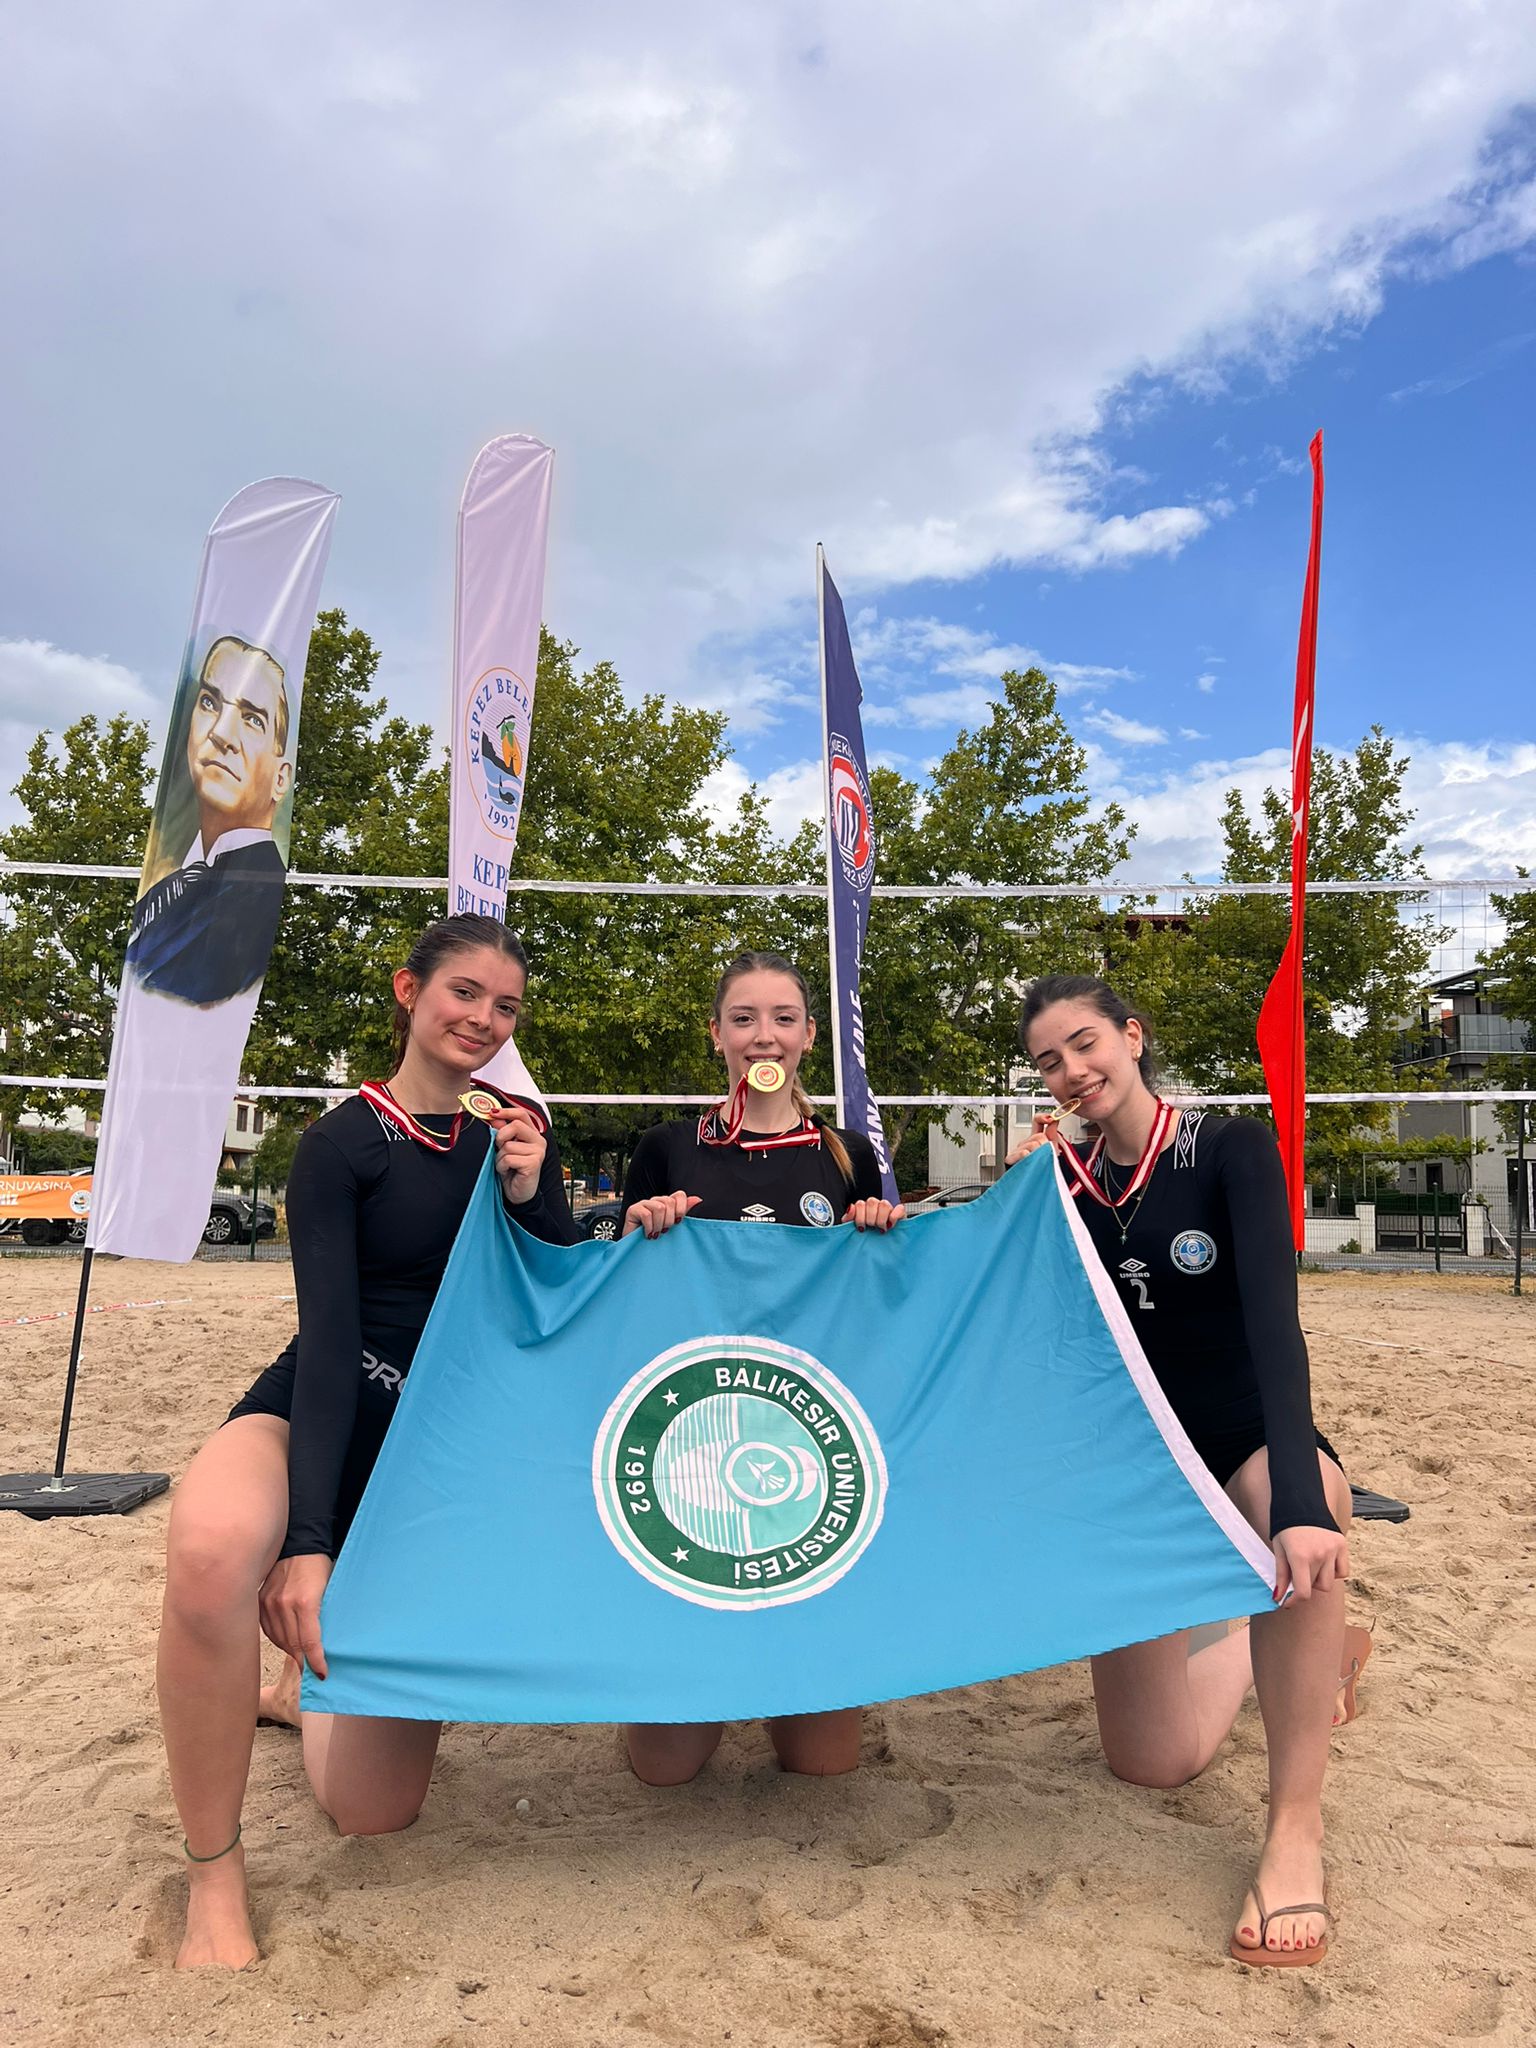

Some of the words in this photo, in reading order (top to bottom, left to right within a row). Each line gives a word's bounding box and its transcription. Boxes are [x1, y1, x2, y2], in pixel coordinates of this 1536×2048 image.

[471, 684, 492, 764] KEPEZ
[488, 805, 515, 830] 1992
[1130, 1279, 1155, 1309] 2
[714, 1366, 841, 1446] BALIKESİR
[624, 1445, 651, 1515] 1992
[734, 1452, 860, 1585] ÜNİVERSİTESİ
